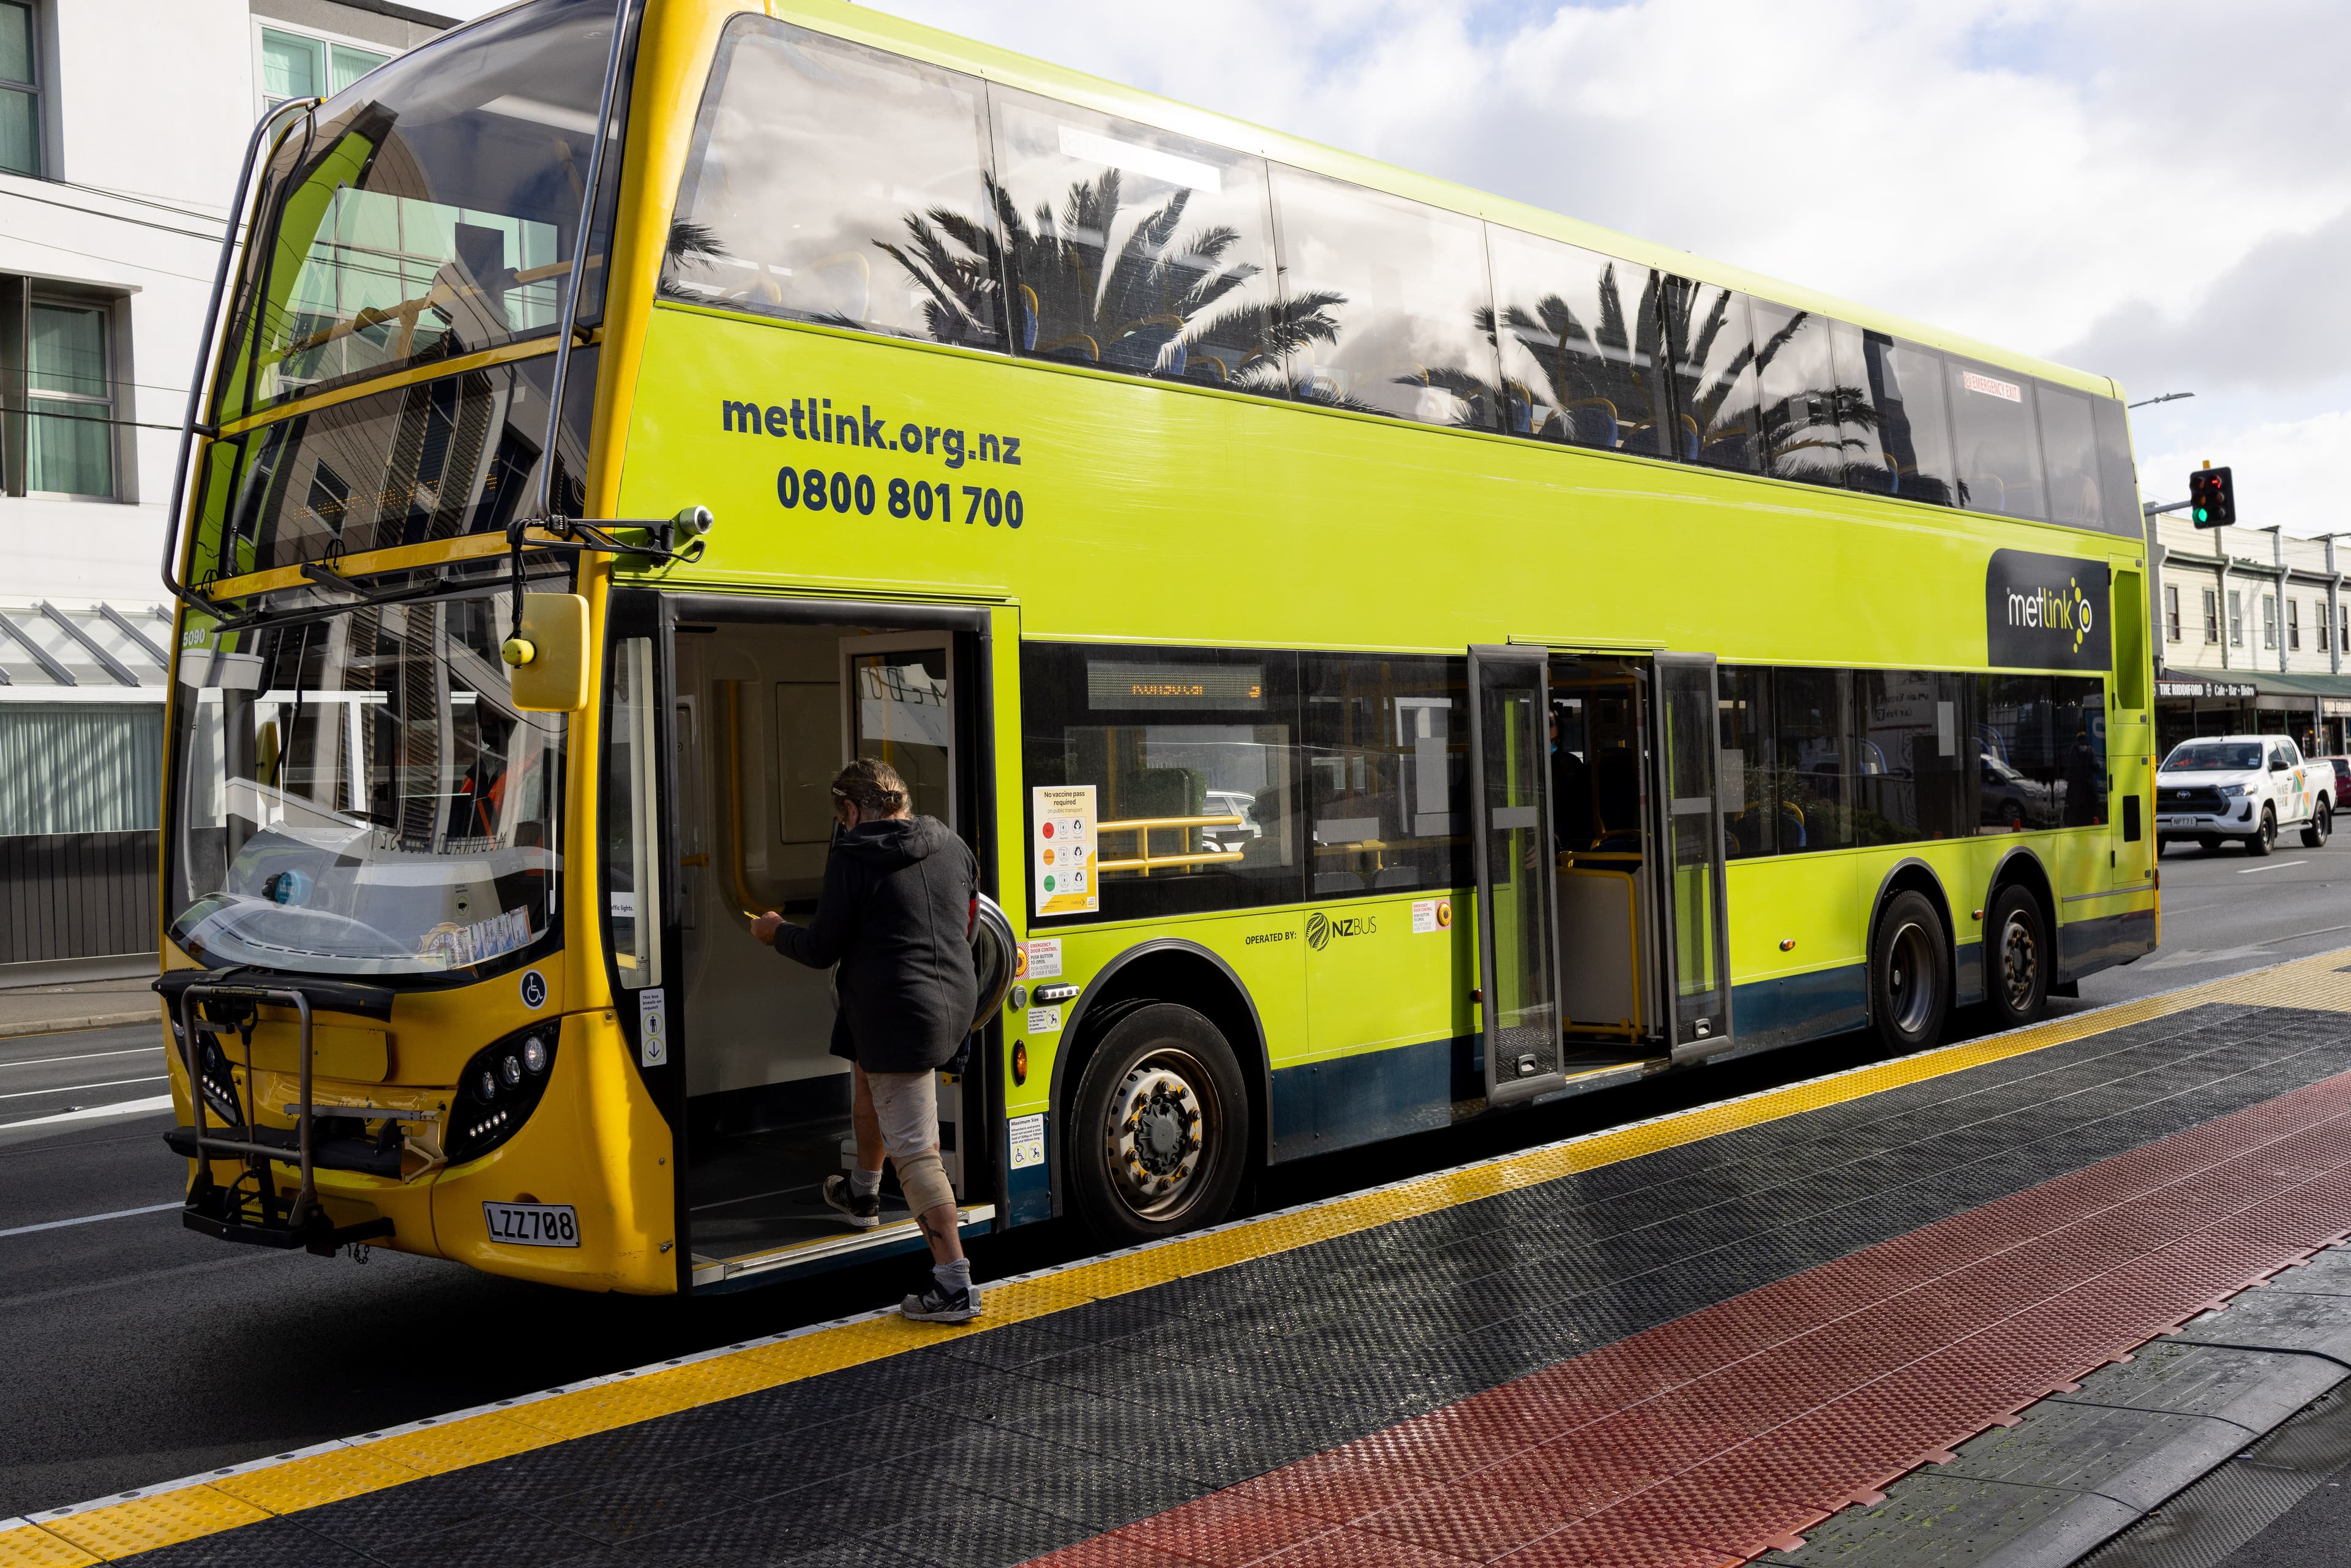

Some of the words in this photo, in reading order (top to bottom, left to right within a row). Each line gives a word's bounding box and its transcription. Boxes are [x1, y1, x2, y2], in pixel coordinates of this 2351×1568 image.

[1971, 375, 2004, 397] EMERGENCY
[2006, 384, 2017, 400] EXIT
[722, 397, 1022, 469] metlink.org.nz
[777, 466, 876, 516] 0800
[888, 477, 951, 523] 801
[962, 485, 1024, 530] 700
[2008, 587, 2074, 630] metlink
[183, 628, 206, 647] 5090
[2159, 683, 2172, 696] THE
[2173, 683, 2203, 696] RIDDIFORD
[2214, 685, 2225, 696] Cafe
[2229, 684, 2238, 696] Bar
[2241, 684, 2255, 696] Bistro
[1245, 933, 1283, 945] OPERATED
[1285, 931, 1297, 940] BY:
[487, 1208, 574, 1241] LZZ708
